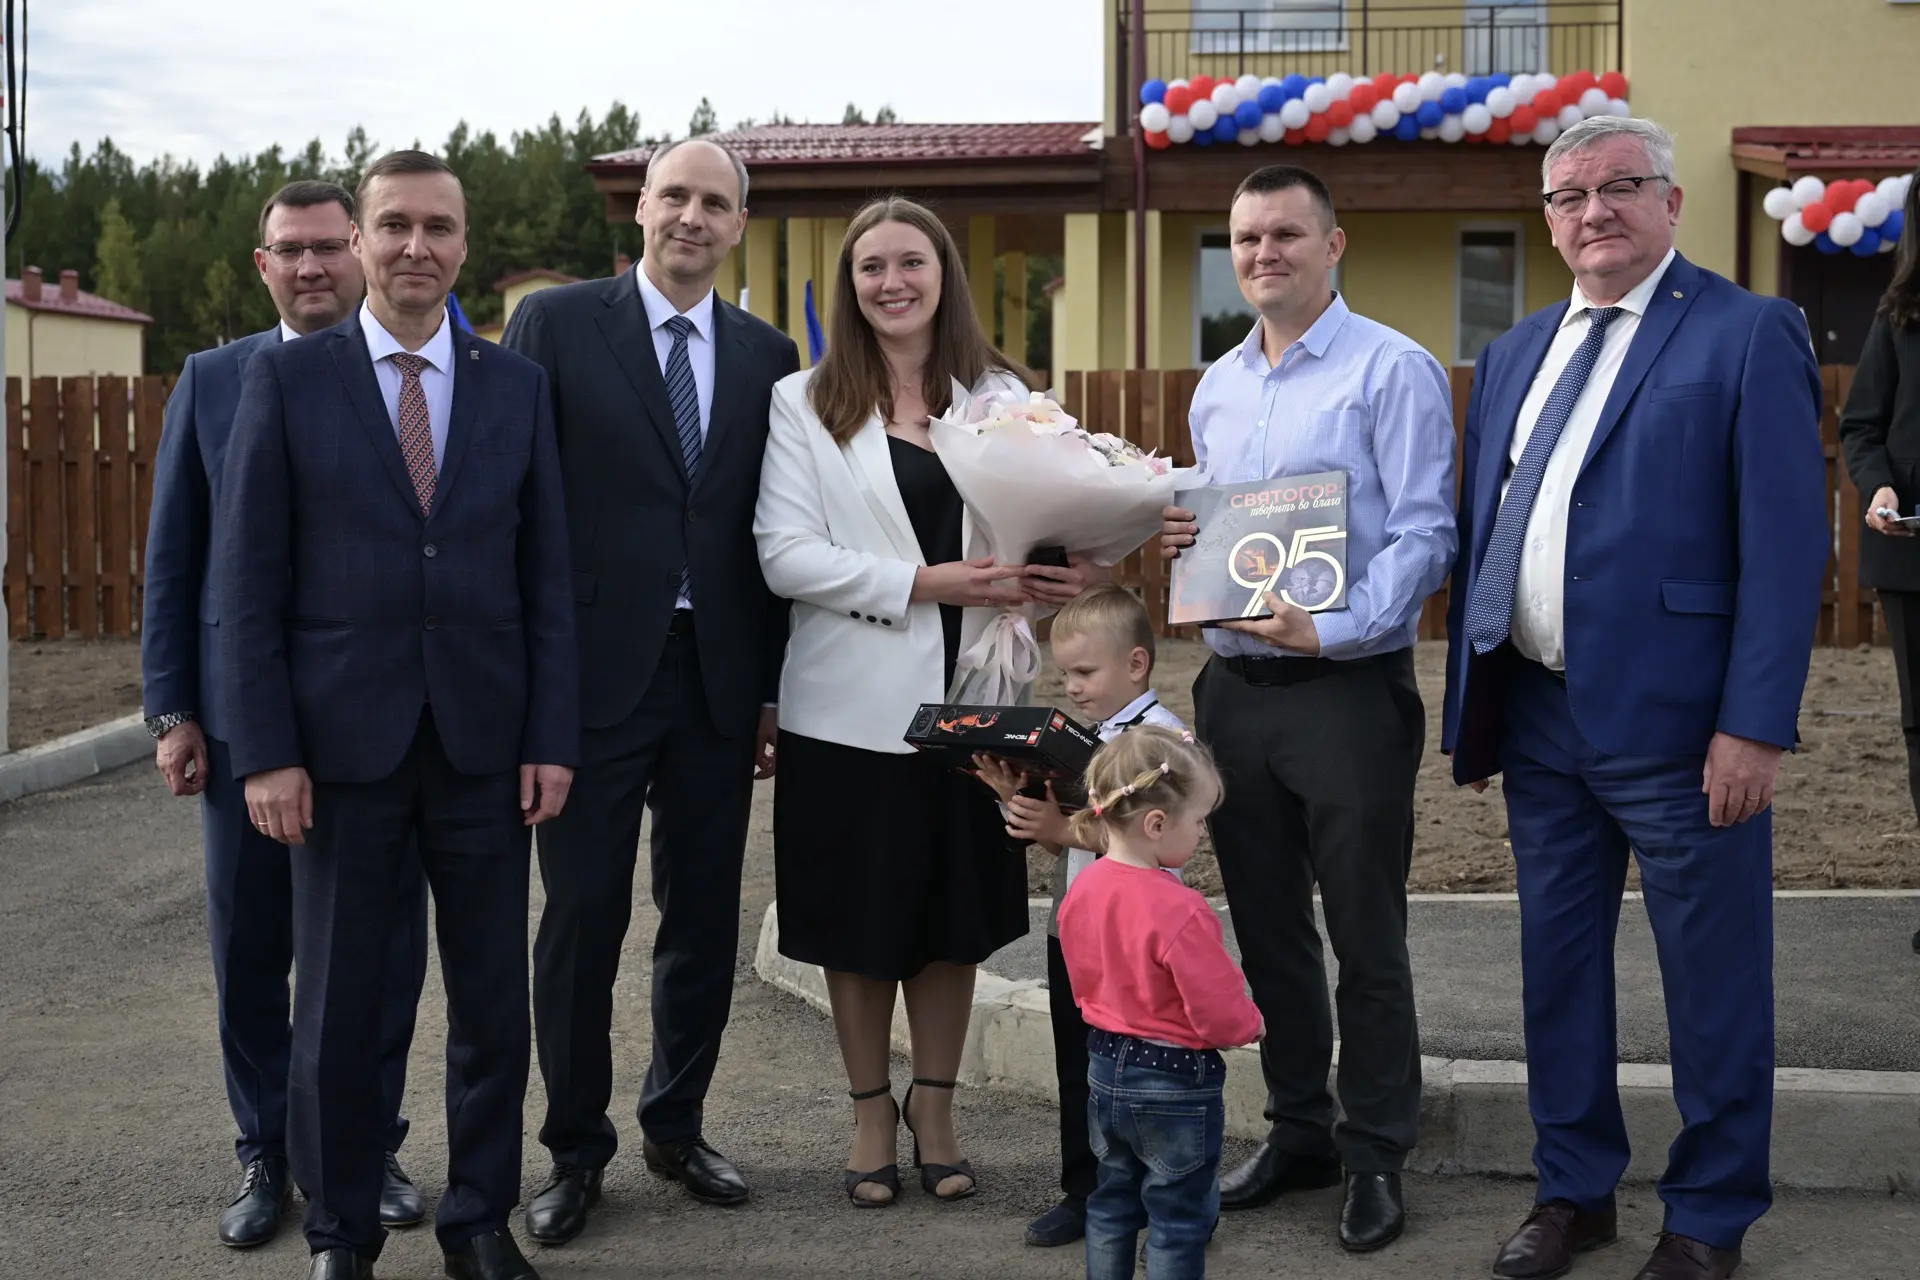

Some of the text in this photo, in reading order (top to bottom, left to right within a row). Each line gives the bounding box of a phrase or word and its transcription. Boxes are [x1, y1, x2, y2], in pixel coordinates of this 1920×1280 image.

[1298, 498, 1310, 510] во
[1312, 485, 1341, 508] благо
[1228, 525, 1347, 617] 95
[1065, 723, 1094, 747] TECHNIC
